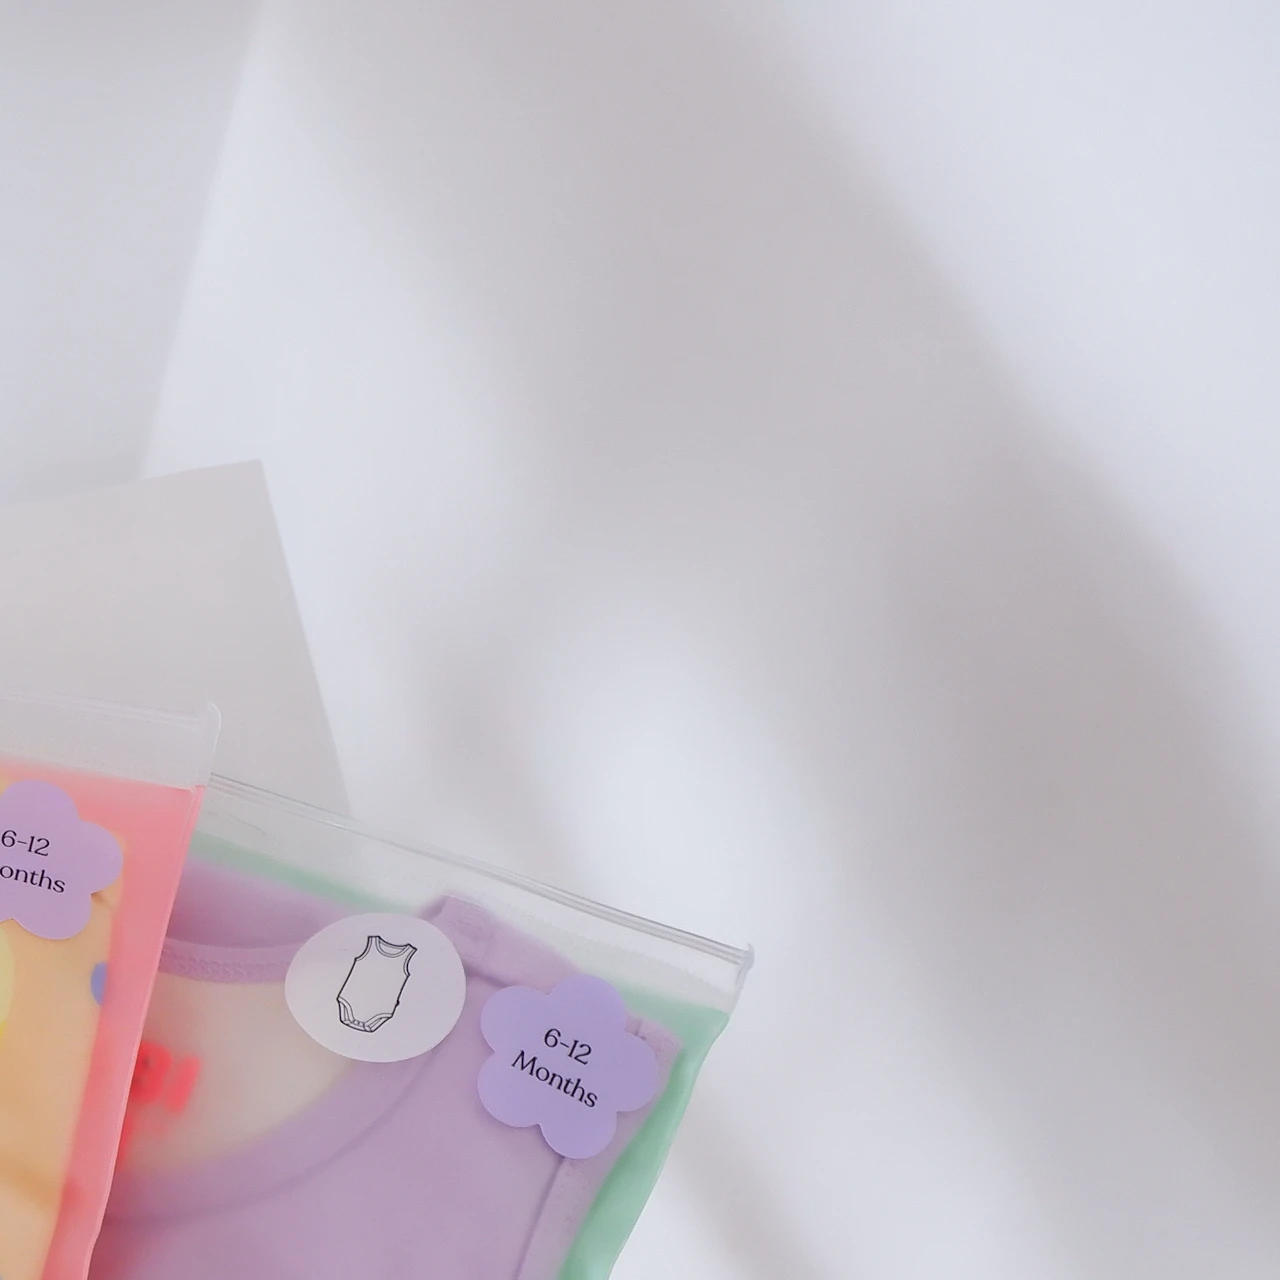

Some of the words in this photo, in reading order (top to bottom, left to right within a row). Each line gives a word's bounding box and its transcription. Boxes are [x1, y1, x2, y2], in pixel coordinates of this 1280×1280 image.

[0, 829, 51, 857] 6-12
[543, 1028, 592, 1065] 6-12
[510, 1049, 598, 1108] Months
